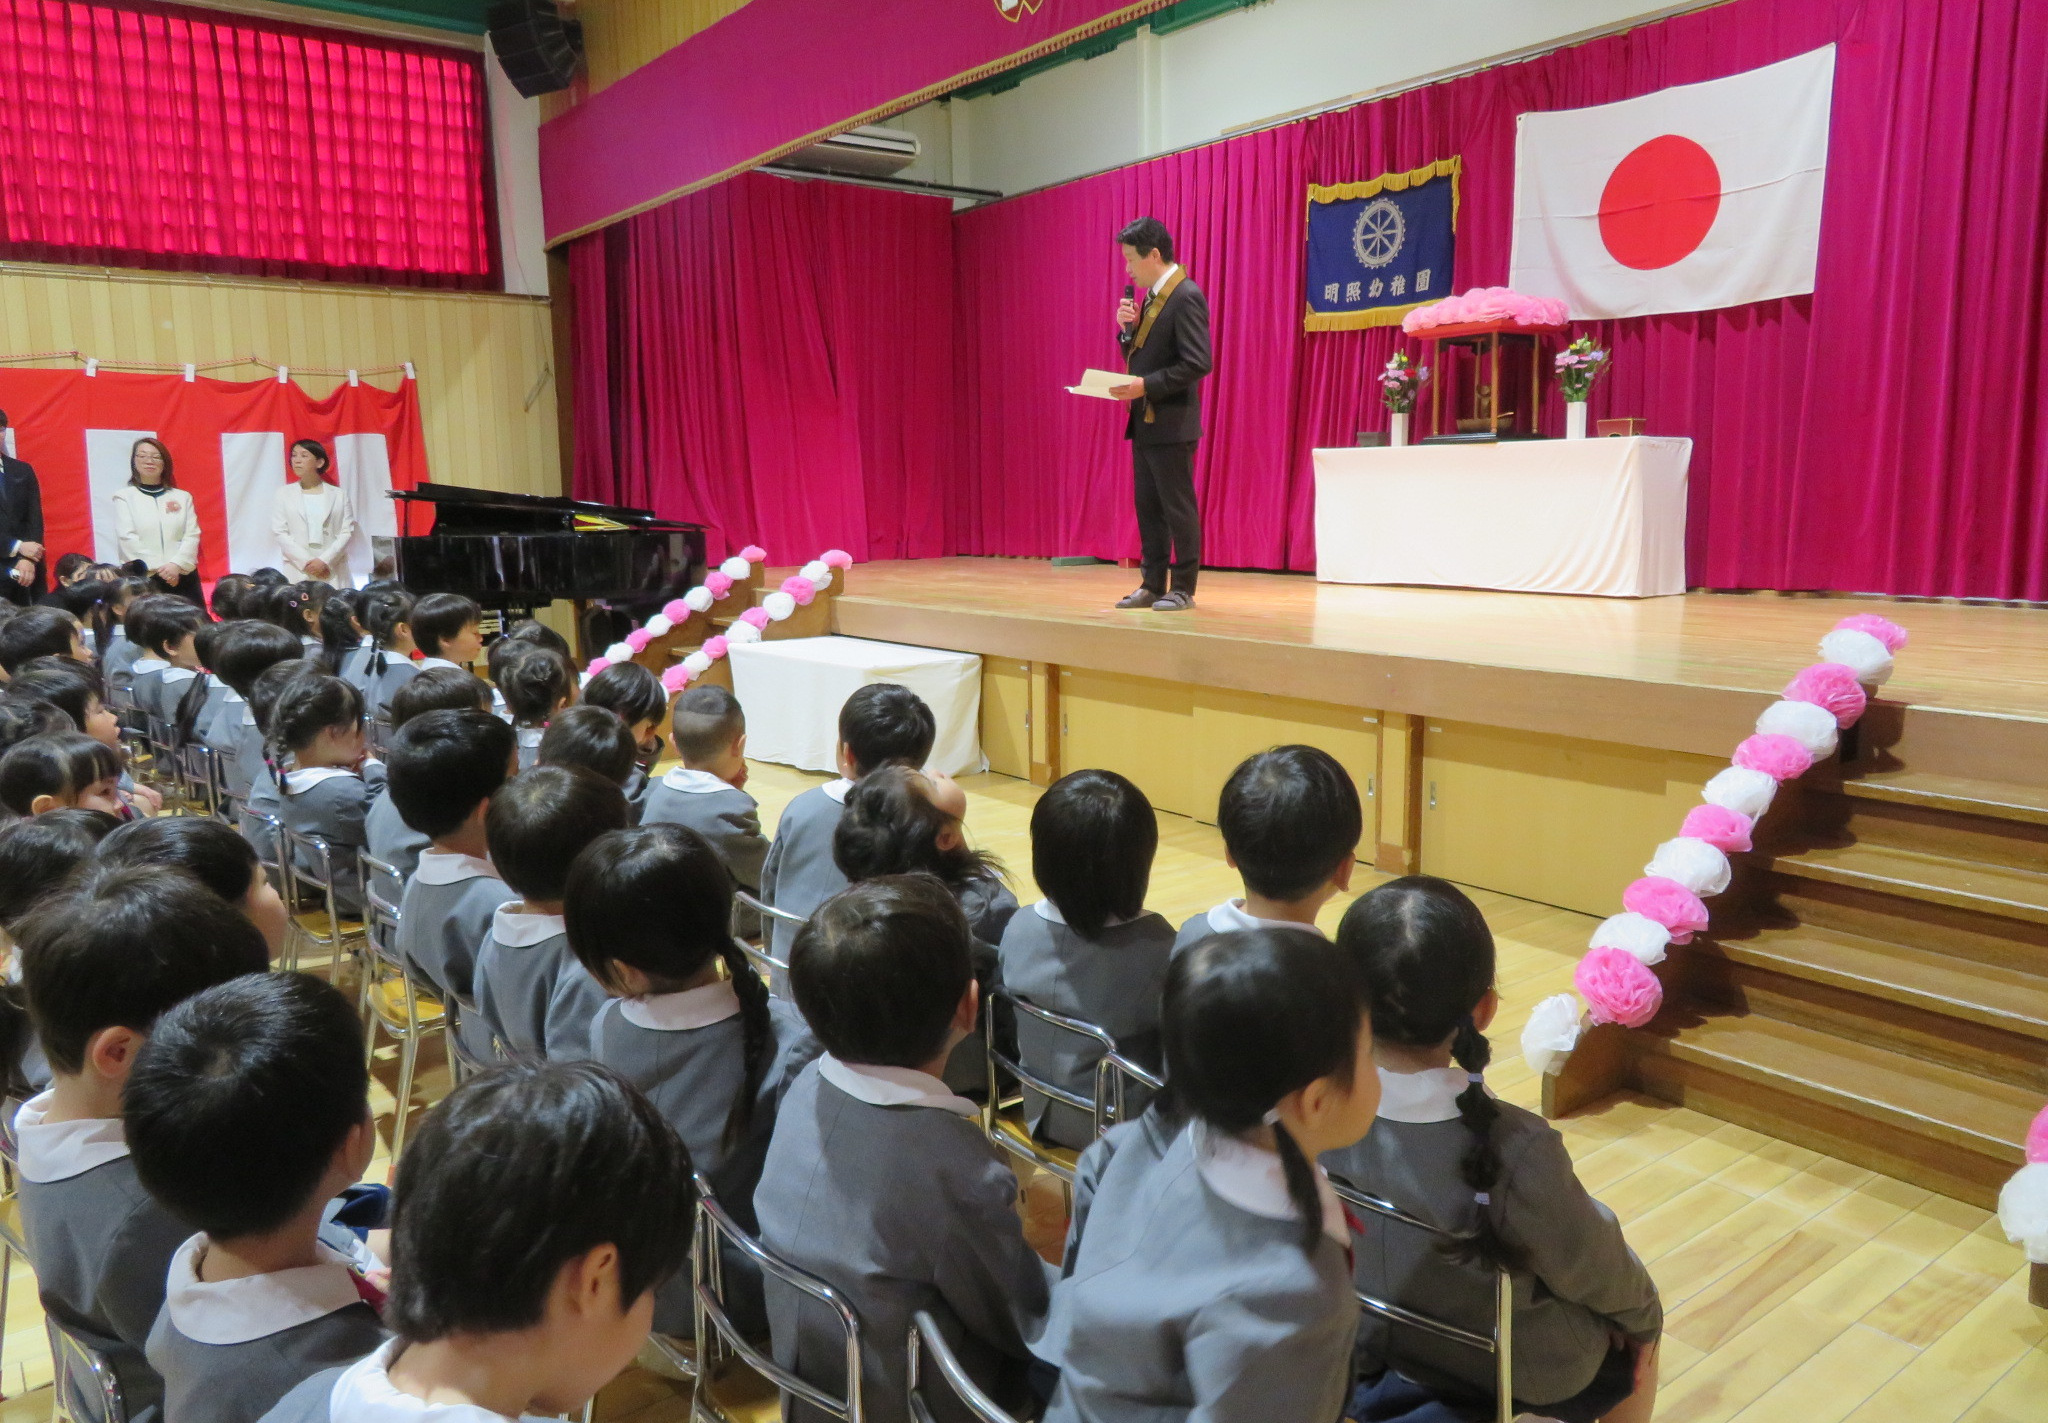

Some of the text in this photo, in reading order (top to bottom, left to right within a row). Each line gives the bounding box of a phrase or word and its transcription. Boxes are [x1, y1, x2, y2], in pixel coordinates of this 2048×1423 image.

[1324, 268, 1431, 303] 明照幼稚園
